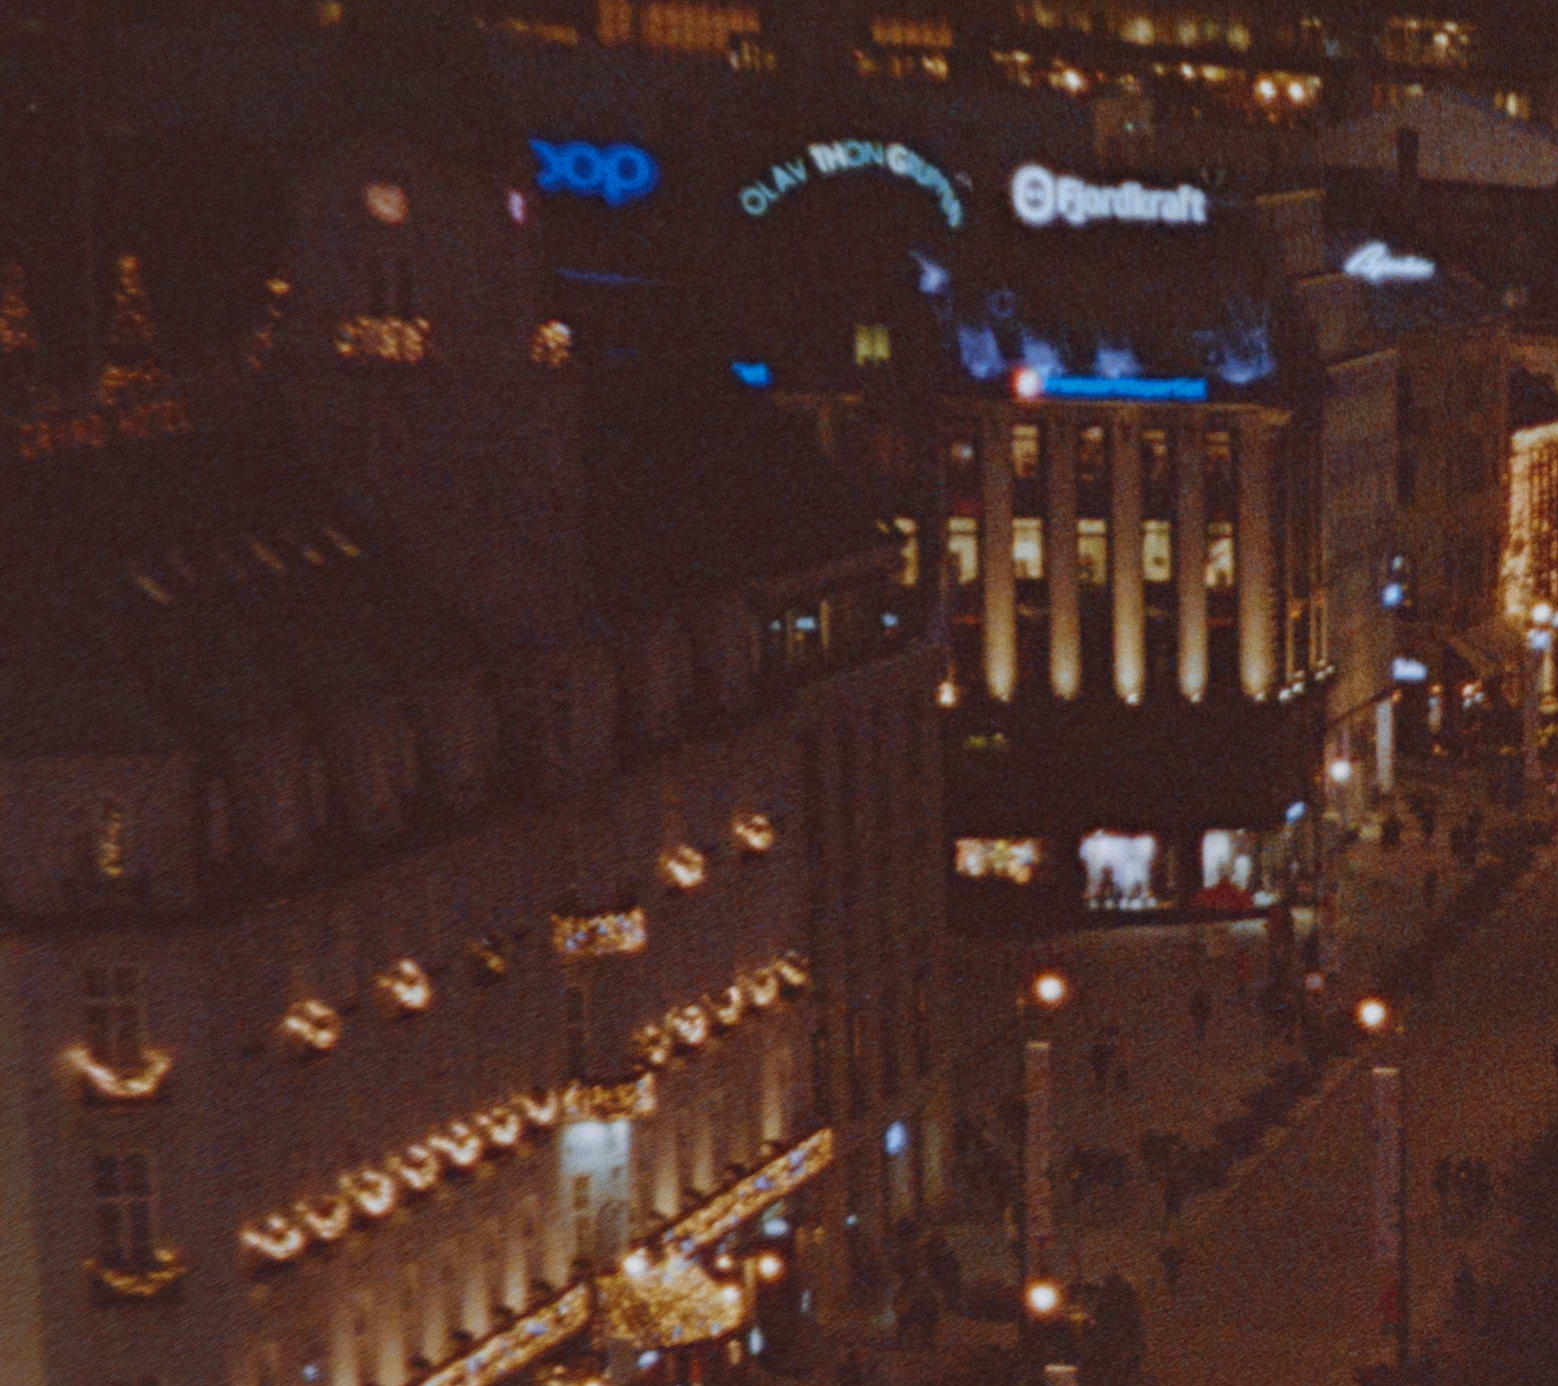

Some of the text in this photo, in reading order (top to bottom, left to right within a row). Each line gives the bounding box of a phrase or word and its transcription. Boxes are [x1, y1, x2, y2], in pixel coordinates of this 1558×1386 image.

[741, 159, 806, 216] OLAV
[808, 140, 884, 174] THON
[1056, 175, 1206, 227] Fjordkraft
